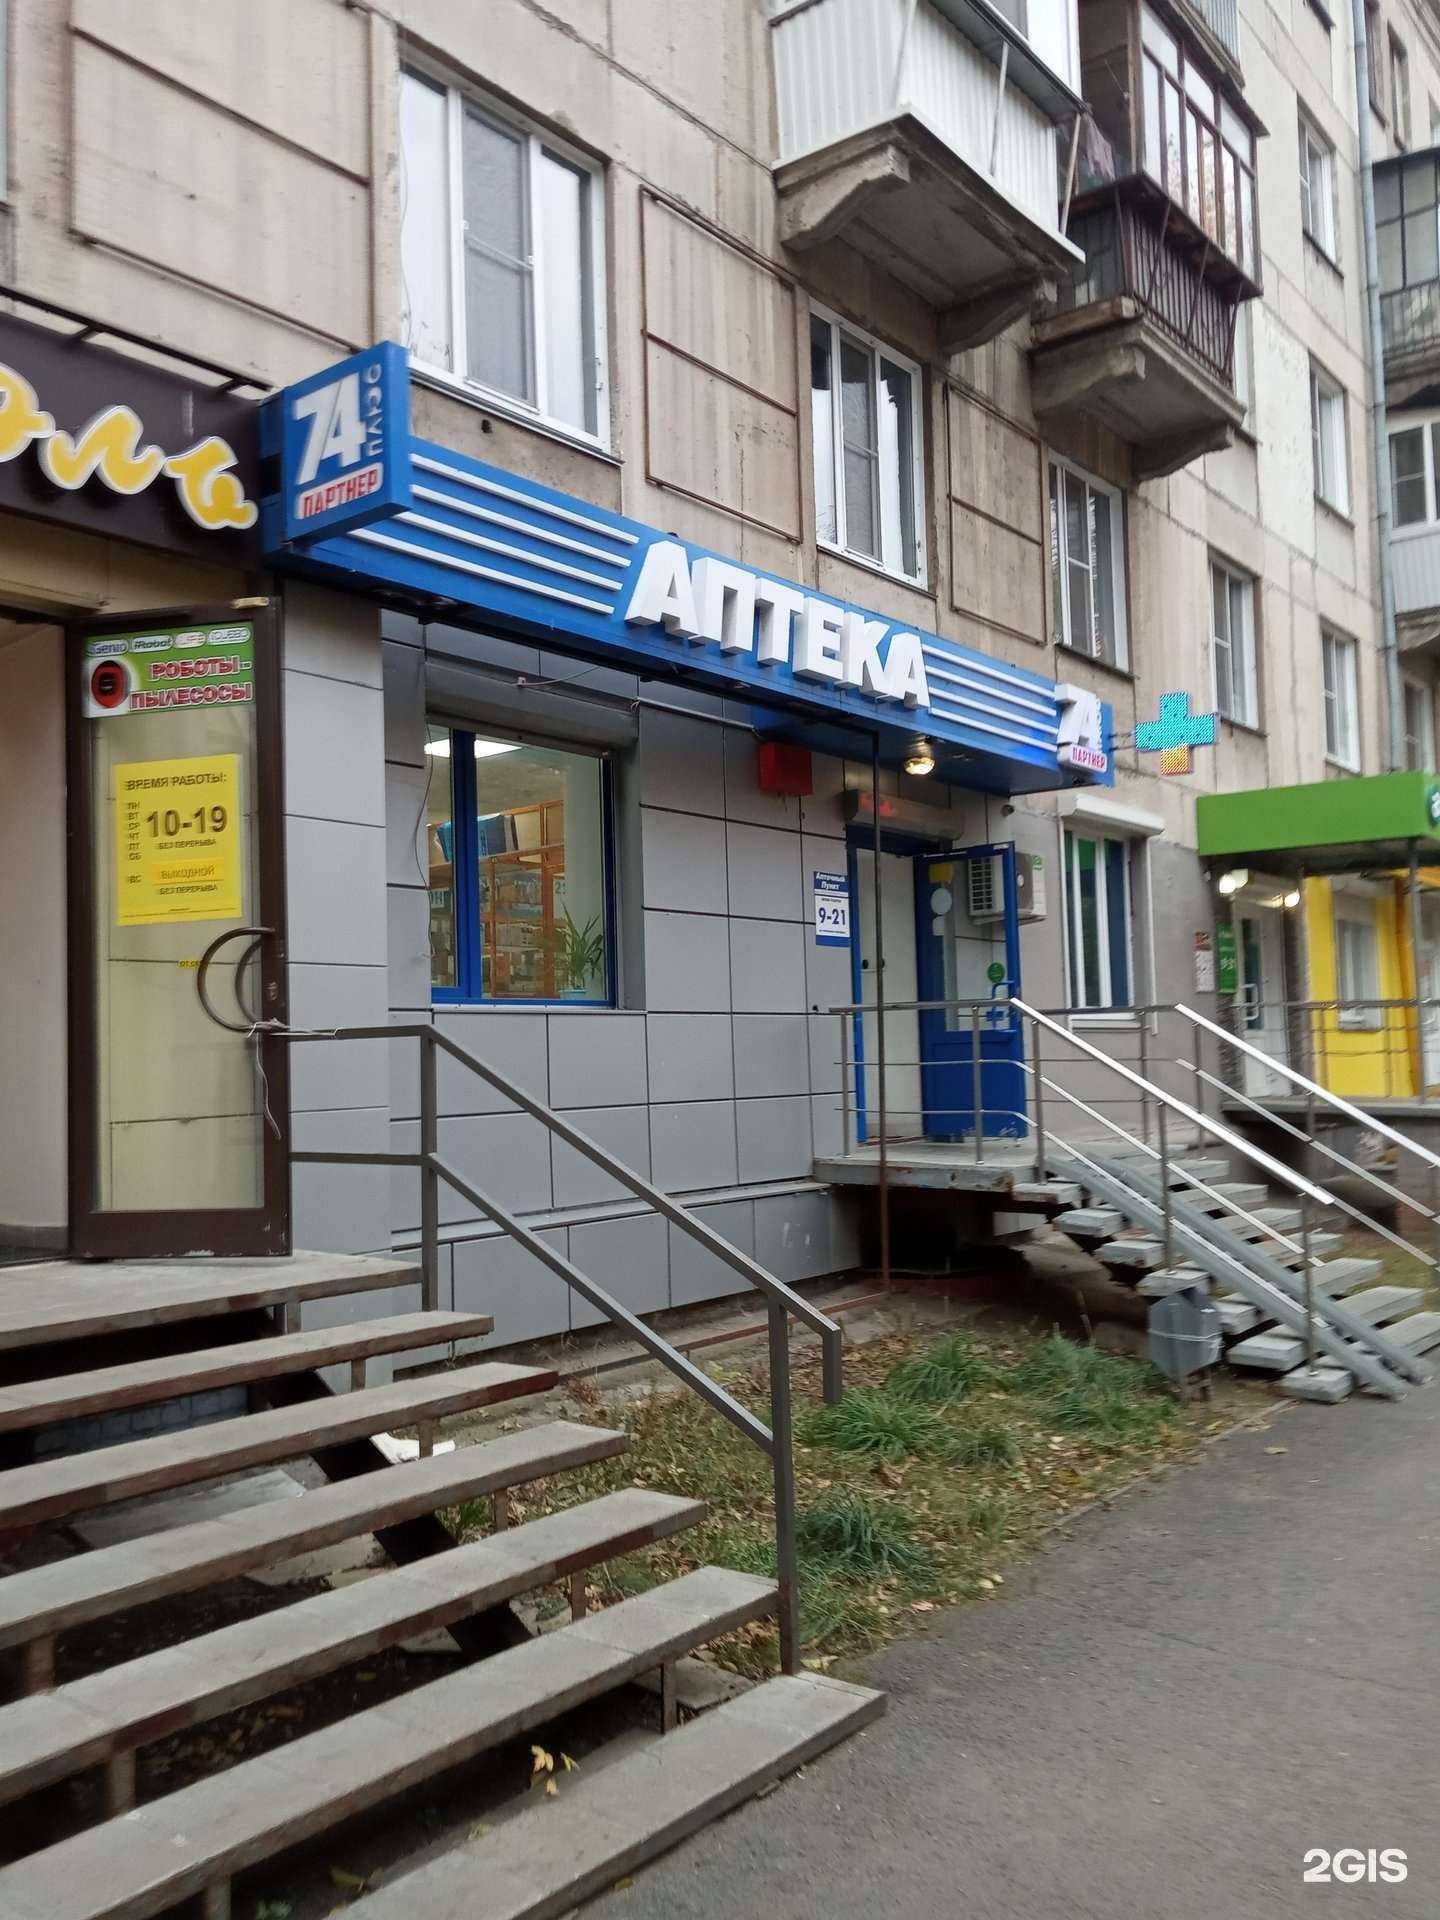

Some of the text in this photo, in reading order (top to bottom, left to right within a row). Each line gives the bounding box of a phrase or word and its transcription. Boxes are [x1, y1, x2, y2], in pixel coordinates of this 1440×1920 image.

[295, 372, 366, 485] 74
[303, 469, 378, 517] ПАРТНЕР
[625, 541, 931, 710] АПТЕКА
[131, 683, 252, 710] ПЫЛЕСОСЫ
[1072, 746, 1105, 769] ПАРТНЕР
[127, 772, 227, 790] ВРЕМЯ РАБОТЫ:
[146, 805, 228, 838] 10-19
[161, 865, 215, 880] ВЫХОДНОЙ
[818, 907, 846, 925] 9-21
